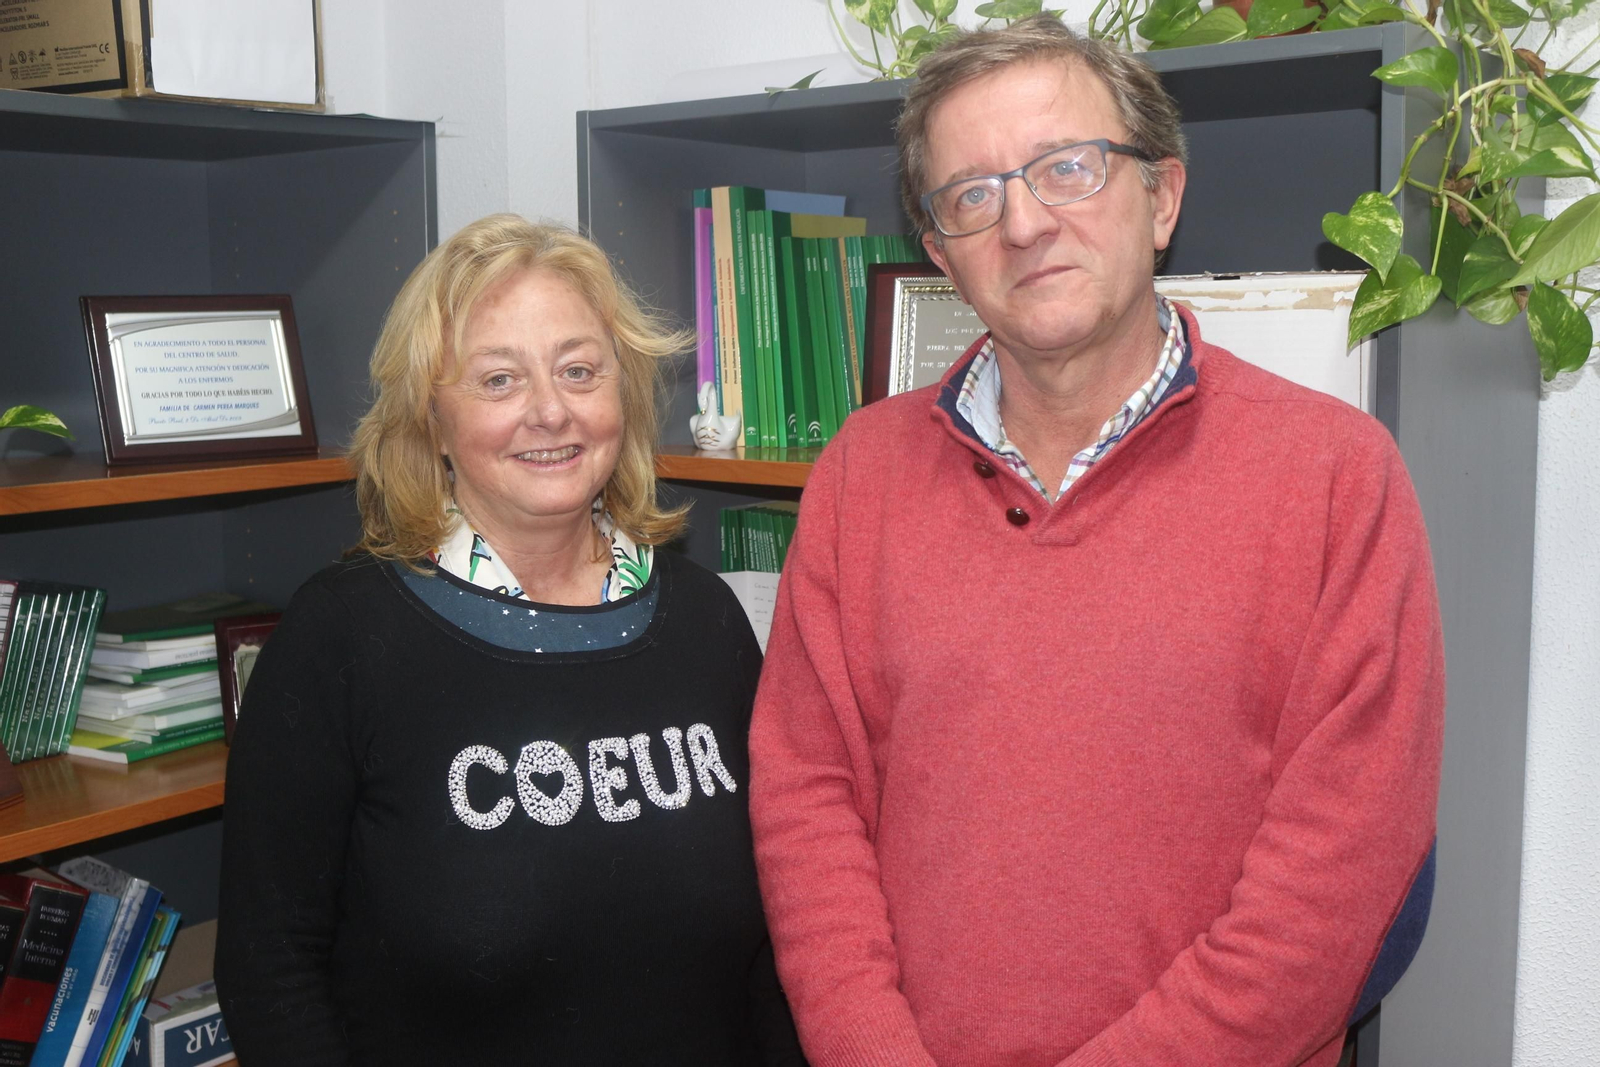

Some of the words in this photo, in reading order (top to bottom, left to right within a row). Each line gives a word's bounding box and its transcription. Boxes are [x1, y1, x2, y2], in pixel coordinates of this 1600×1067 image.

[195, 364, 226, 372] ATENCIÓN
[232, 363, 270, 371] DEDICACIÓN
[141, 391, 169, 399] GRACIAS
[213, 390, 226, 398] QUE
[228, 388, 250, 396] HABÉIS
[448, 723, 737, 830] COEUR
[23, 939, 64, 956] Medicina
[25, 954, 57, 966] Interna
[45, 966, 74, 1034] vacunaciones
